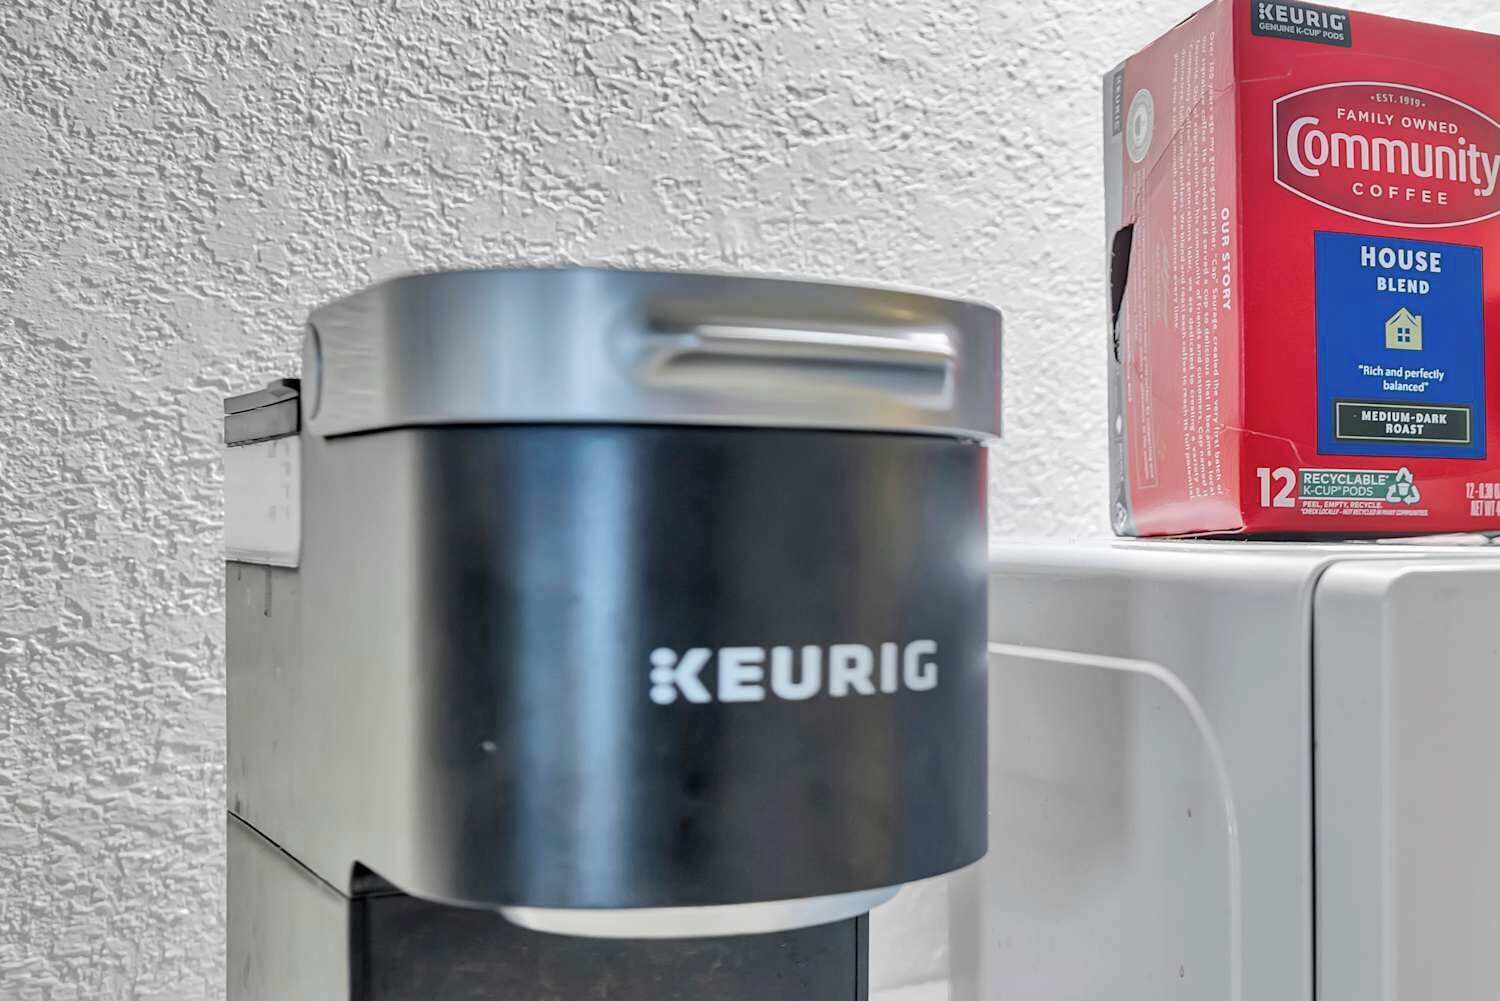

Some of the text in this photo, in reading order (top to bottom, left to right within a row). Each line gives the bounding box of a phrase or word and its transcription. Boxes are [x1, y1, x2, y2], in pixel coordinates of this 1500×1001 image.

[1258, 3, 1344, 30] KEURIG
[1259, 22, 1295, 34] GENUINE
[1323, 32, 1344, 40] PODS
[1337, 108, 1458, 135] FAMILY OWNED
[1352, 182, 1448, 205] COFFEE
[1221, 208, 1231, 310] OUR STORY
[1360, 246, 1442, 273] HOUSE
[1377, 277, 1430, 295] BLEND
[1386, 367, 1404, 378] and
[1405, 368, 1444, 382] perfectly
[1362, 410, 1448, 424] MEDIUM-DARK
[1386, 423, 1424, 435] ROAST
[1256, 467, 1296, 508] 12
[1342, 486, 1374, 496] PODS
[650, 640, 938, 705] KEURIG
